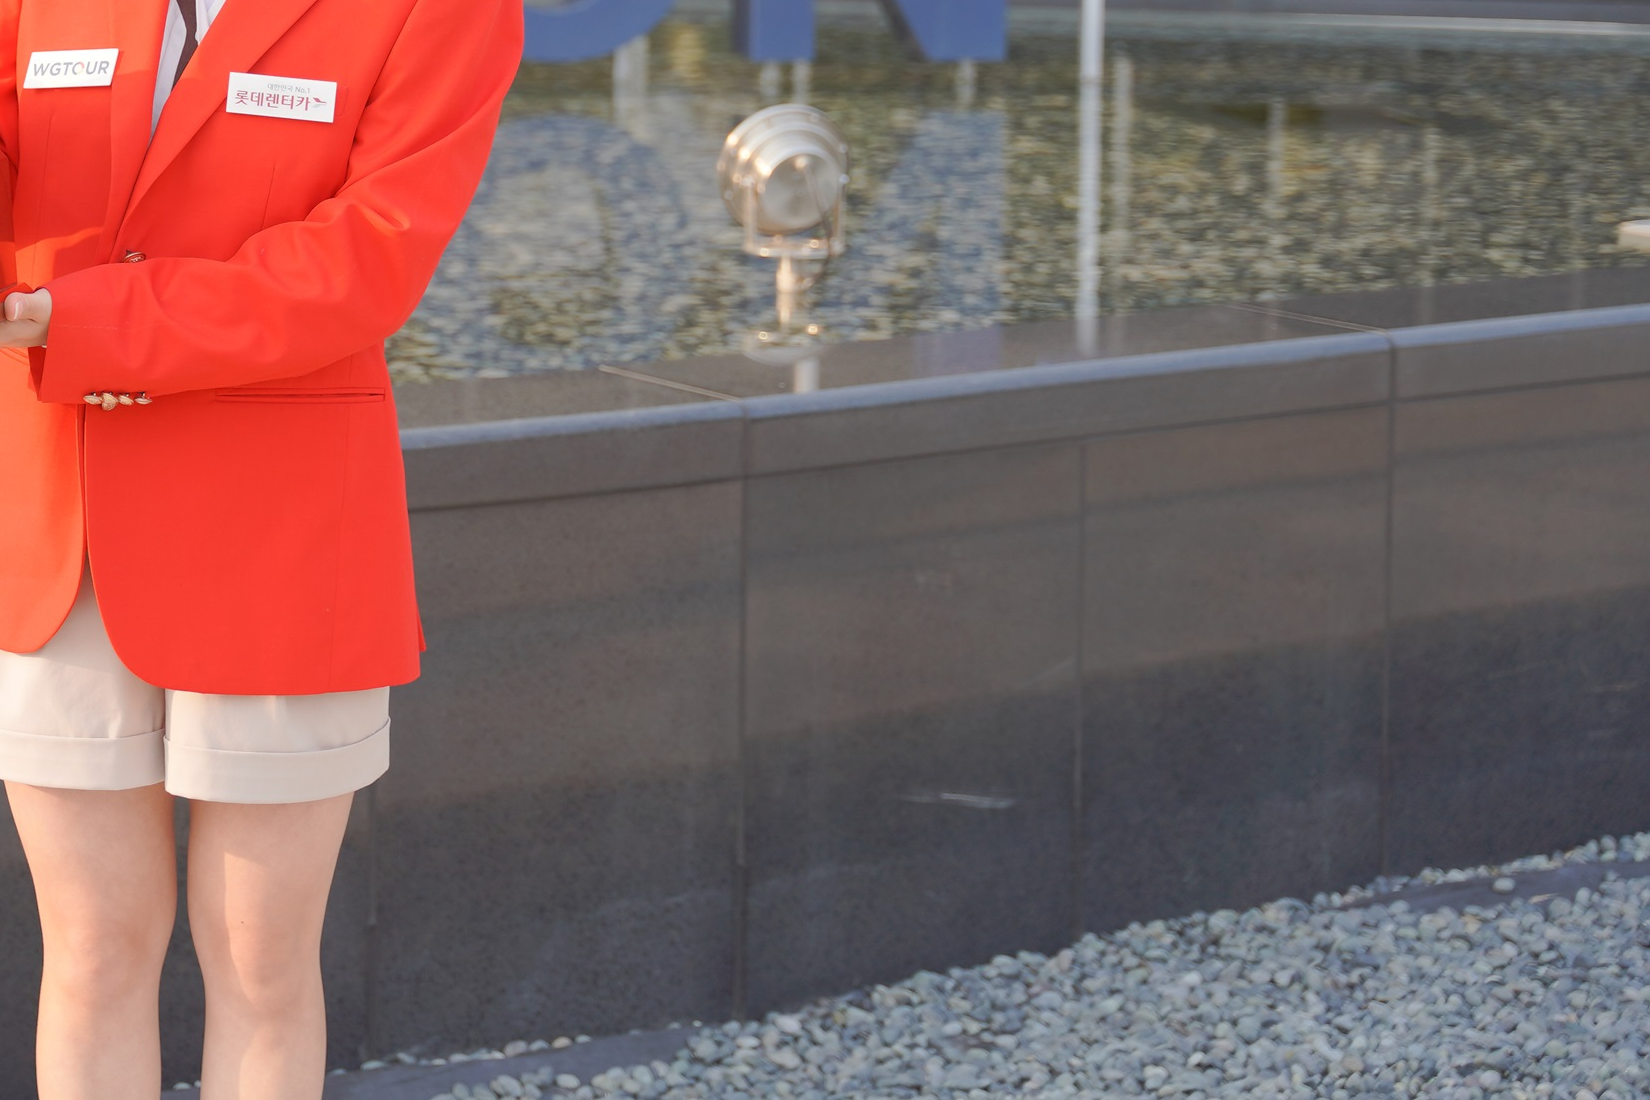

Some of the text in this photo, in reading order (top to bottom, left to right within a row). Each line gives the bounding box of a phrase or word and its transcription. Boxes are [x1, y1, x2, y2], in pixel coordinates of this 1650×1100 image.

[33, 60, 110, 77] WGTOUR
[295, 86, 311, 94] No.1
[235, 89, 311, 112] 롯데렌터카
